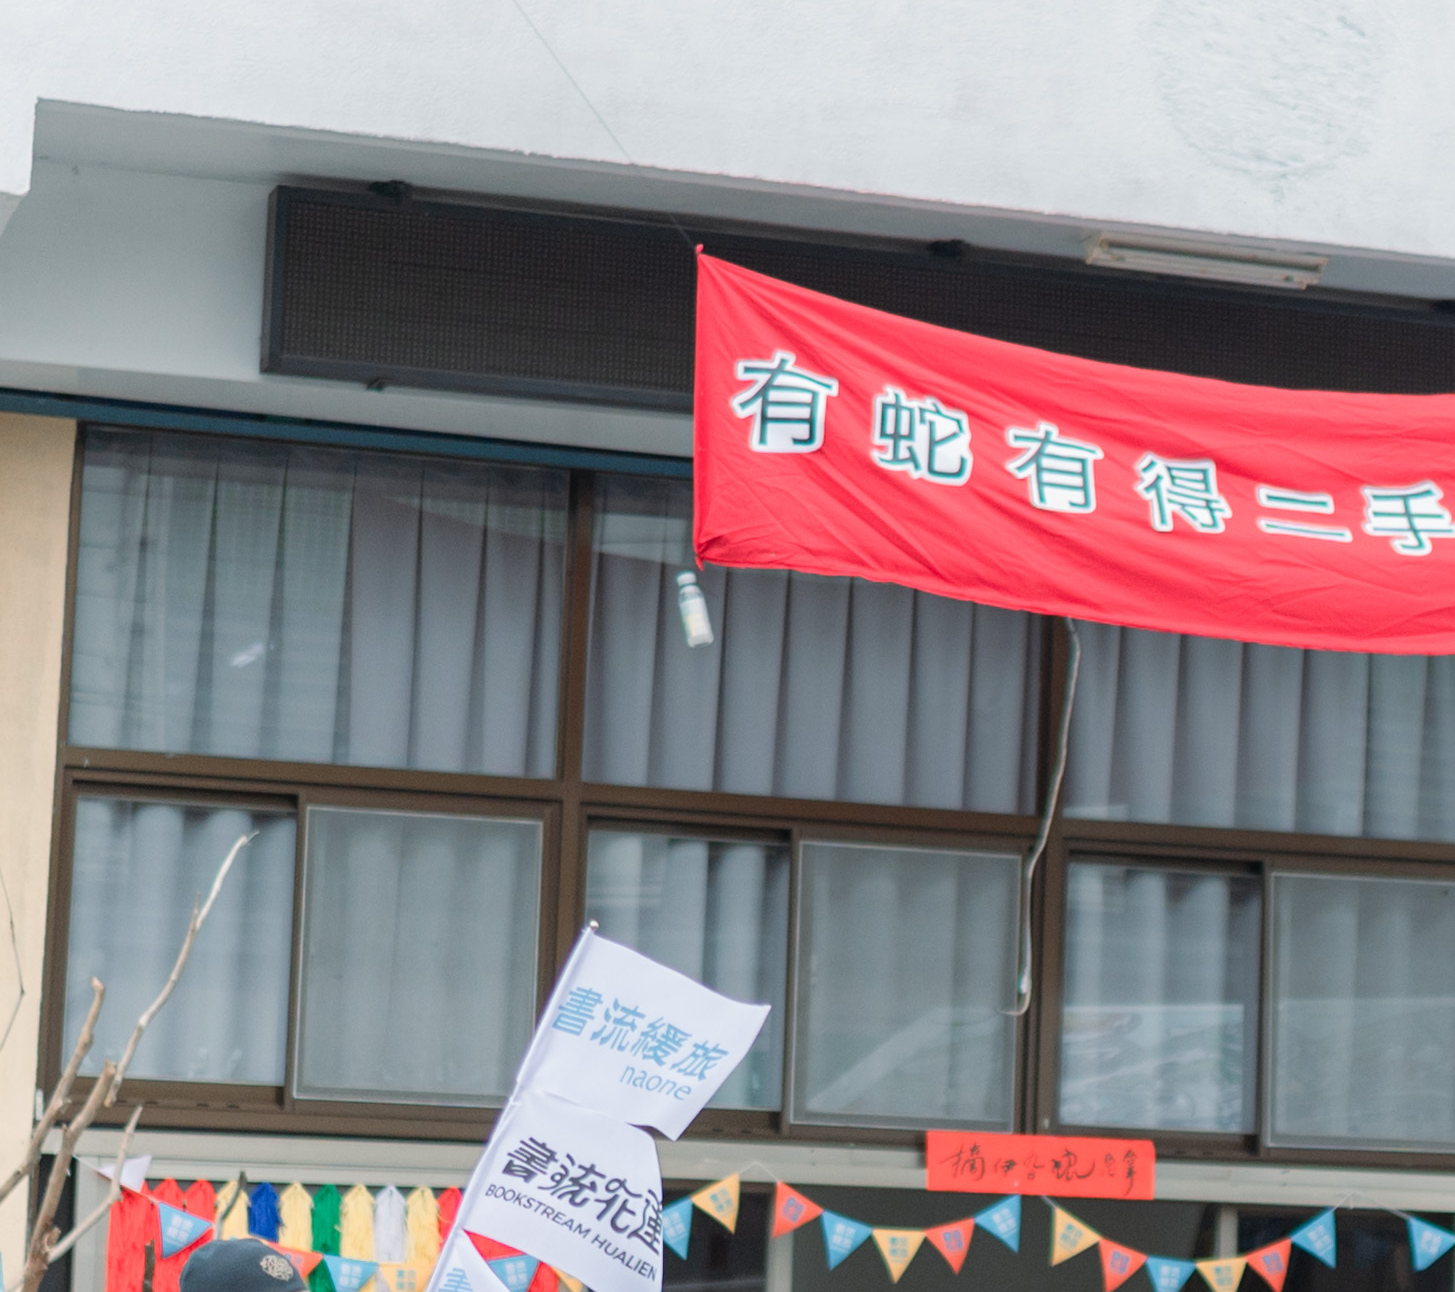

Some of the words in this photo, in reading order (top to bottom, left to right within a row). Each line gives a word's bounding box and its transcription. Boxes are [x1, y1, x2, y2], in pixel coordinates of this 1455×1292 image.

[552, 985, 730, 1082] 書流緩旅
[484, 1183, 592, 1239] BOOKSTREAM
[590, 1233, 658, 1283] HUALIEN
